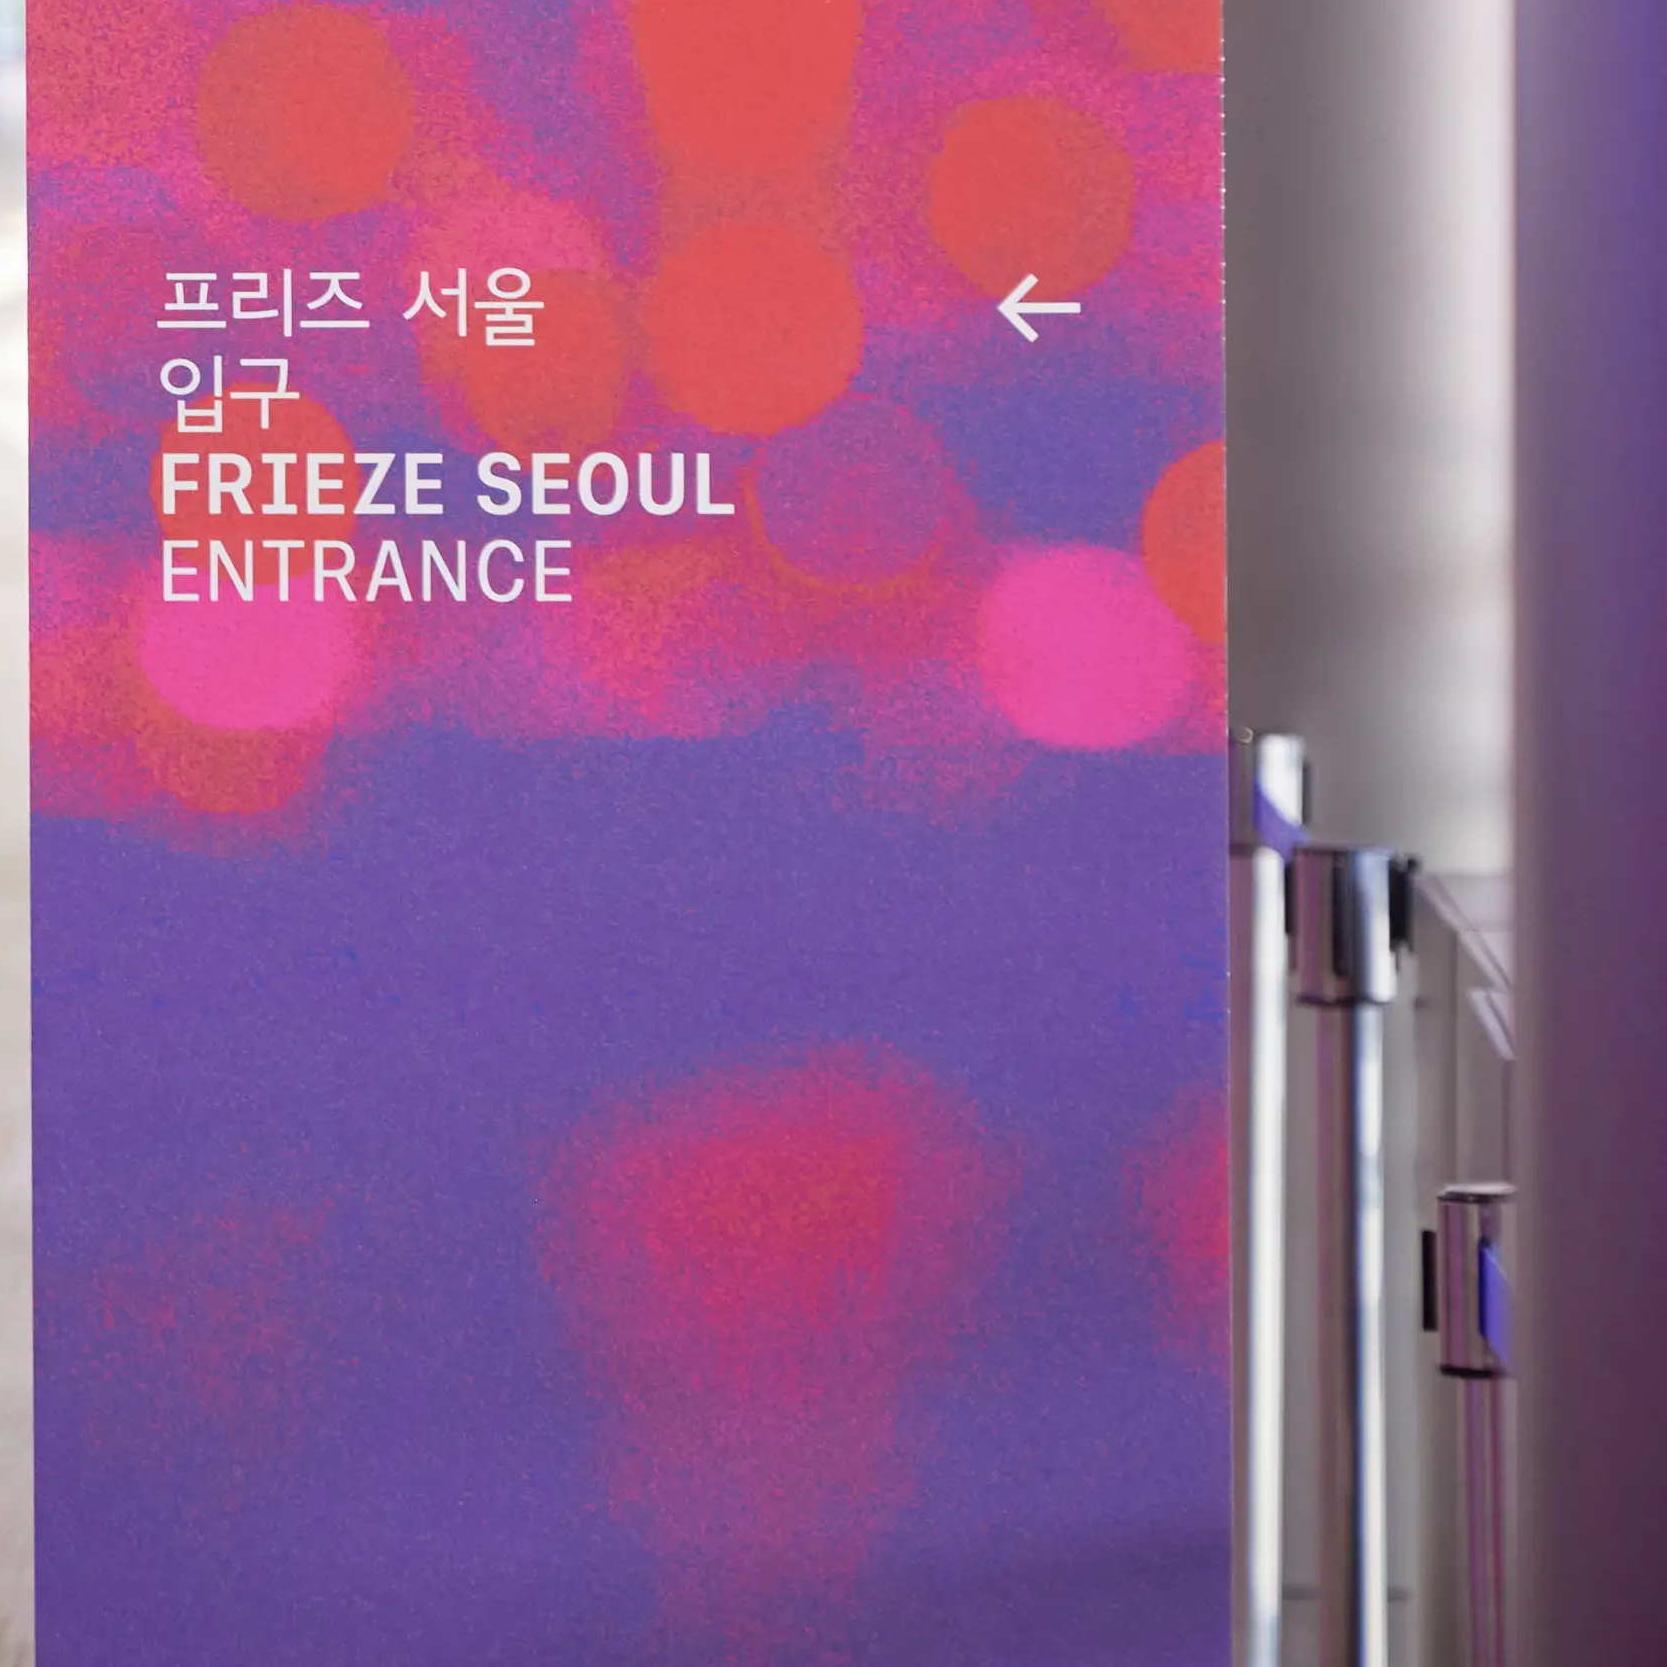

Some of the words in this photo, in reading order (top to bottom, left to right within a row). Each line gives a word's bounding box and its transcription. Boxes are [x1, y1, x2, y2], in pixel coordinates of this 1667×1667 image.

[156, 268, 370, 338] 프리즈
[403, 267, 545, 346] 서울
[160, 355, 300, 433] 입구
[162, 452, 444, 515] FRIEZE
[477, 451, 735, 516] SEOUL
[163, 539, 572, 603] ENTRANCE
